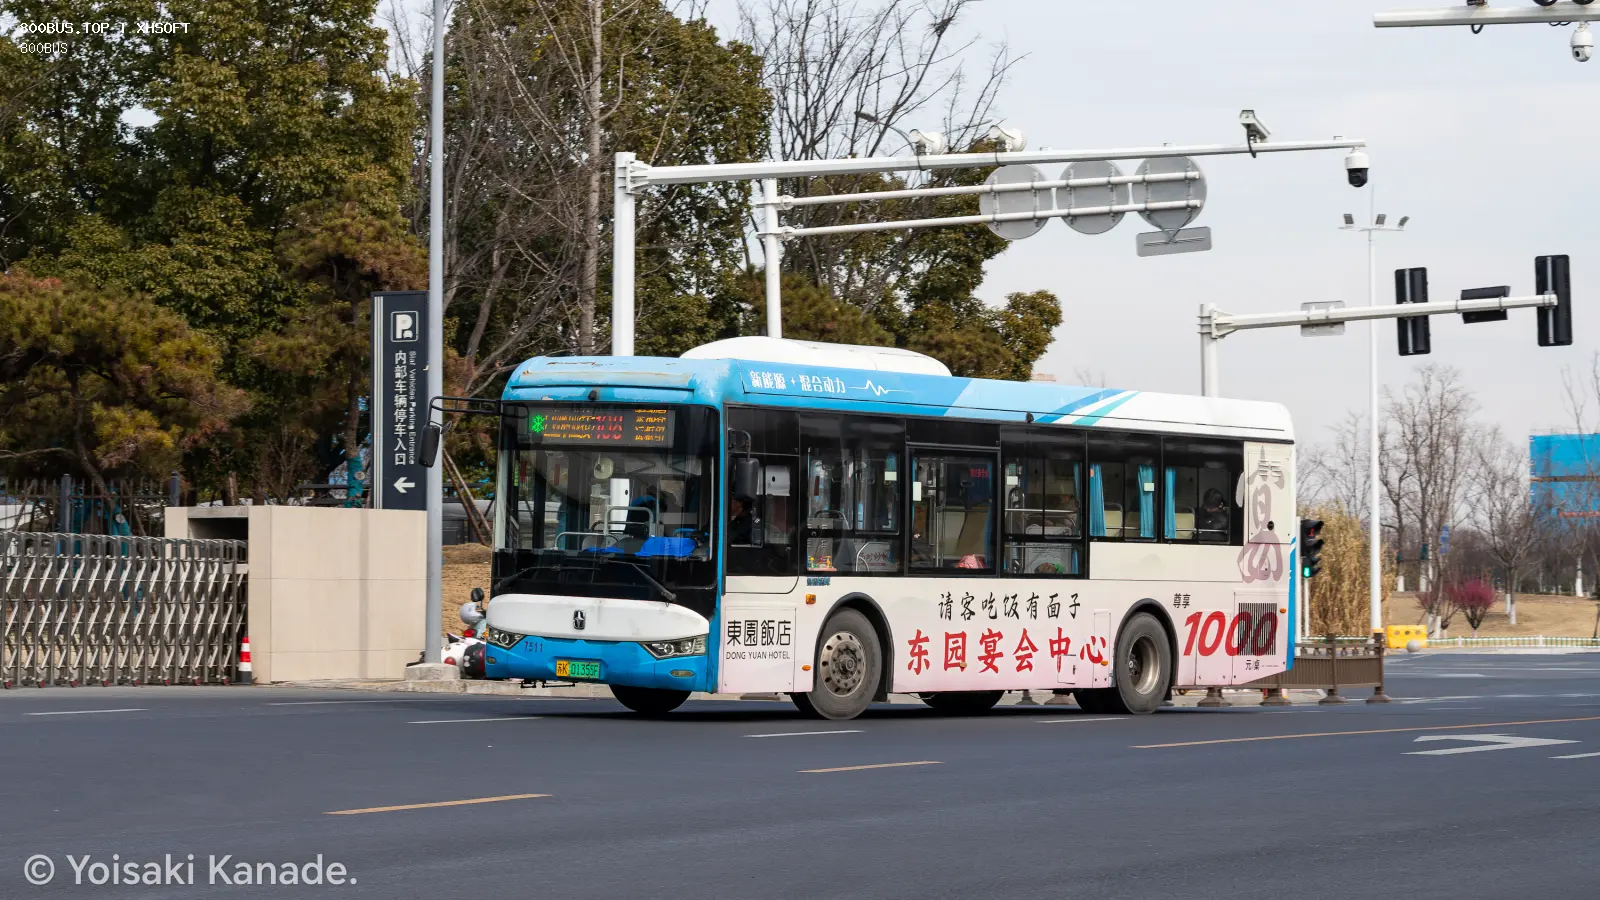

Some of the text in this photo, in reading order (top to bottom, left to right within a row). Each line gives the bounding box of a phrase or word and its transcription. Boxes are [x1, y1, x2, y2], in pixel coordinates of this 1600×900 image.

[750, 370, 846, 394] 新能源 混合动力
[394, 350, 407, 466] 内部车辆停车入口
[408, 402, 416, 429] Parking
[408, 431, 416, 465] Entrance
[938, 591, 1081, 621] 请客吃饭有面子
[1173, 592, 1191, 609] 尊享
[727, 619, 791, 646] 東園飯店
[1183, 610, 1279, 657] 1000
[525, 641, 543, 653] 7511
[726, 650, 790, 660] DONG YUAN HOTEL
[907, 626, 1107, 676] 东园宴会中心
